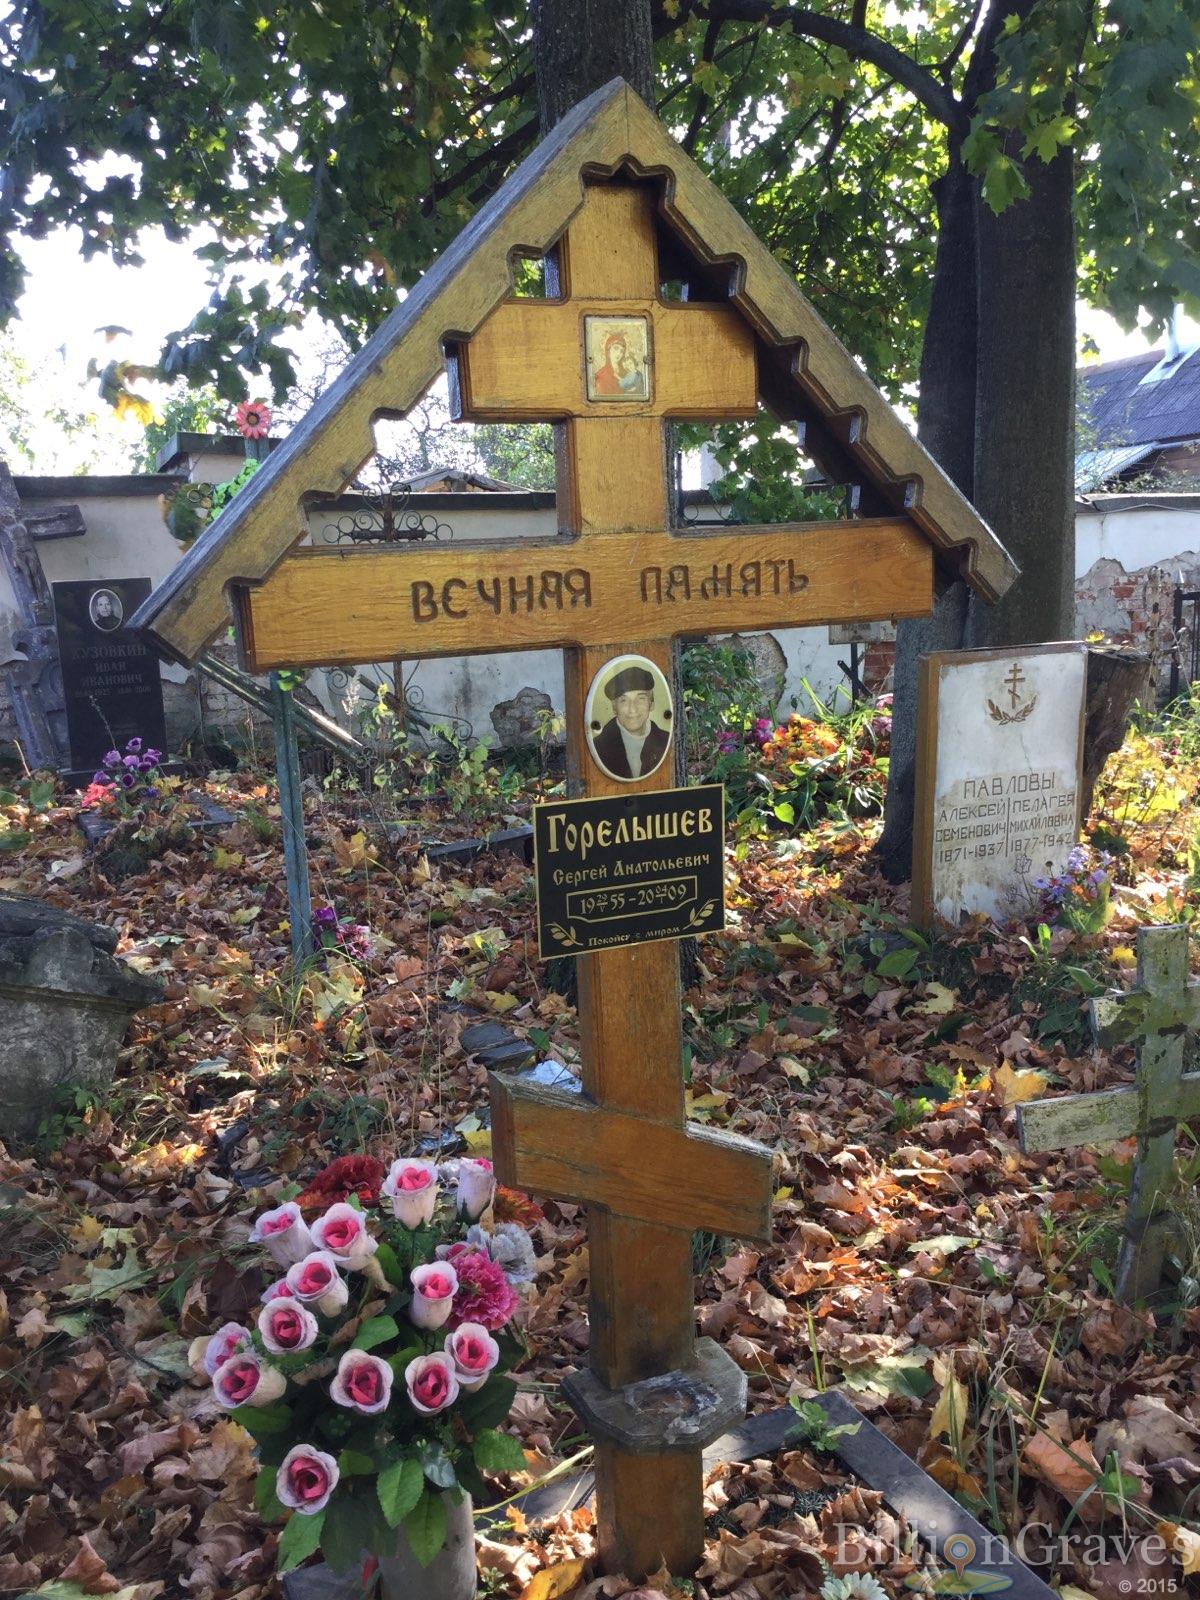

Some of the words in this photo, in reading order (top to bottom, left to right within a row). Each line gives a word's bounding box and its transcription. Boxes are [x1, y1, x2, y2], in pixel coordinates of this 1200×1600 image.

[963, 772, 1056, 800] ПАВЛОВЫ
[939, 802, 1006, 823] АЛЕКСЕЙ
[1012, 793, 1075, 814] ПЕЛАГЕЯ
[935, 823, 1006, 843] СЕМЕНОВИЧ
[1009, 813, 1074, 834] МИХАЙЛОВНА
[547, 808, 713, 861] Горелышев
[553, 864, 608, 887] Сергей
[613, 853, 710, 877] Анатольевич
